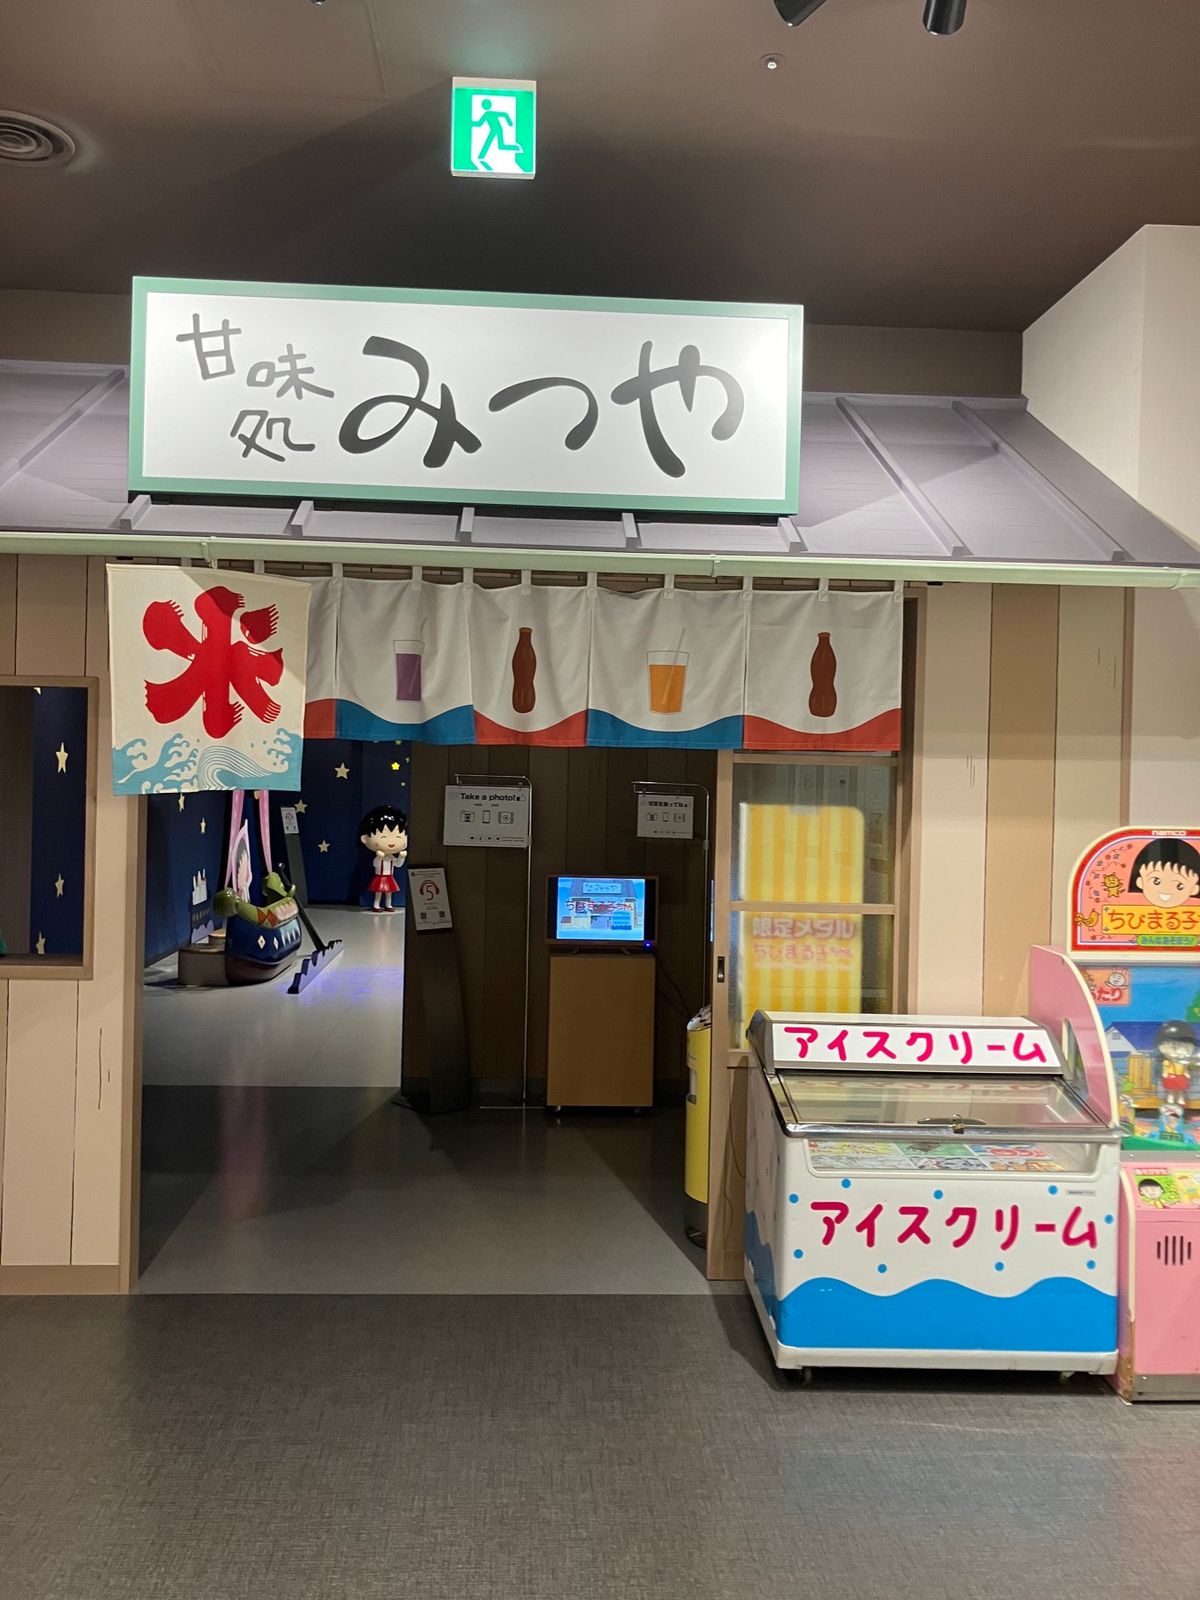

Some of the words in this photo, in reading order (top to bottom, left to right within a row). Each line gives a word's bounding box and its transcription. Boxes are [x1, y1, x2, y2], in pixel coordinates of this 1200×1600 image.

[338, 335, 745, 478] みつや
[142, 585, 284, 739] 氷
[460, 792, 480, 800] Take
[752, 917, 855, 939] 限定メダル
[1108, 909, 1200, 930] ちびまる子
[784, 1027, 1047, 1064] アイスクリーム
[810, 1201, 1098, 1251] アイスクリーム
